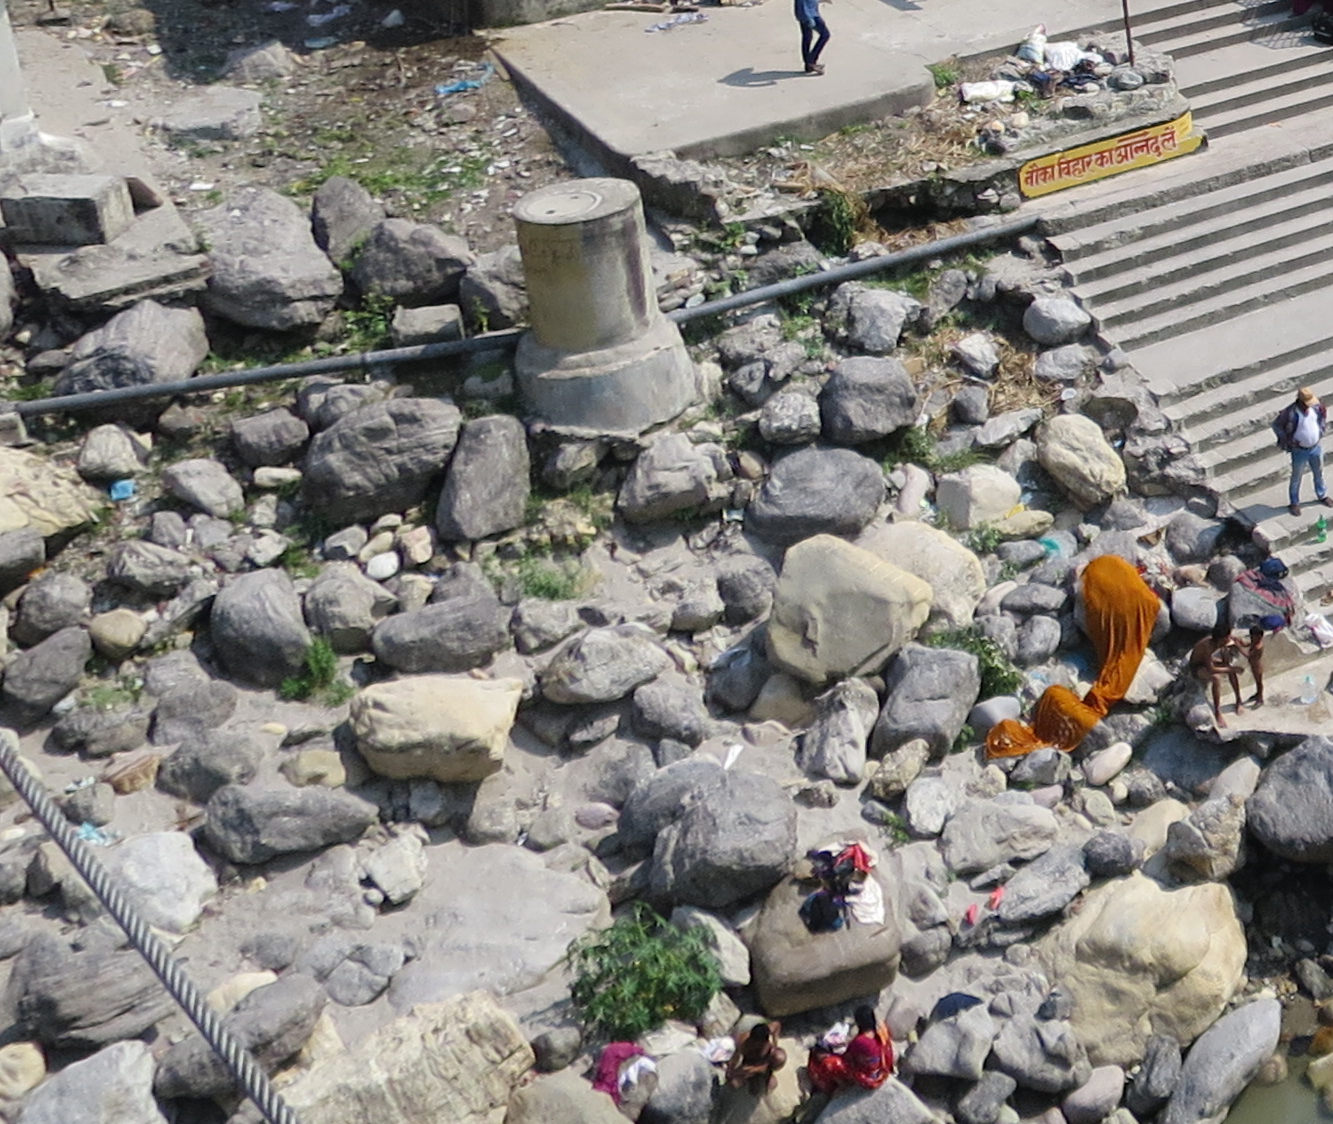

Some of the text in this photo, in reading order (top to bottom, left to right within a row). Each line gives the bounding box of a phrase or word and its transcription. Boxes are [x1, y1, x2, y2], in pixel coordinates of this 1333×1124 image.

[1024, 161, 1057, 187] नौका
[1057, 154, 1095, 179] विहार
[1095, 148, 1115, 169] का
[1159, 126, 1178, 151] लें
